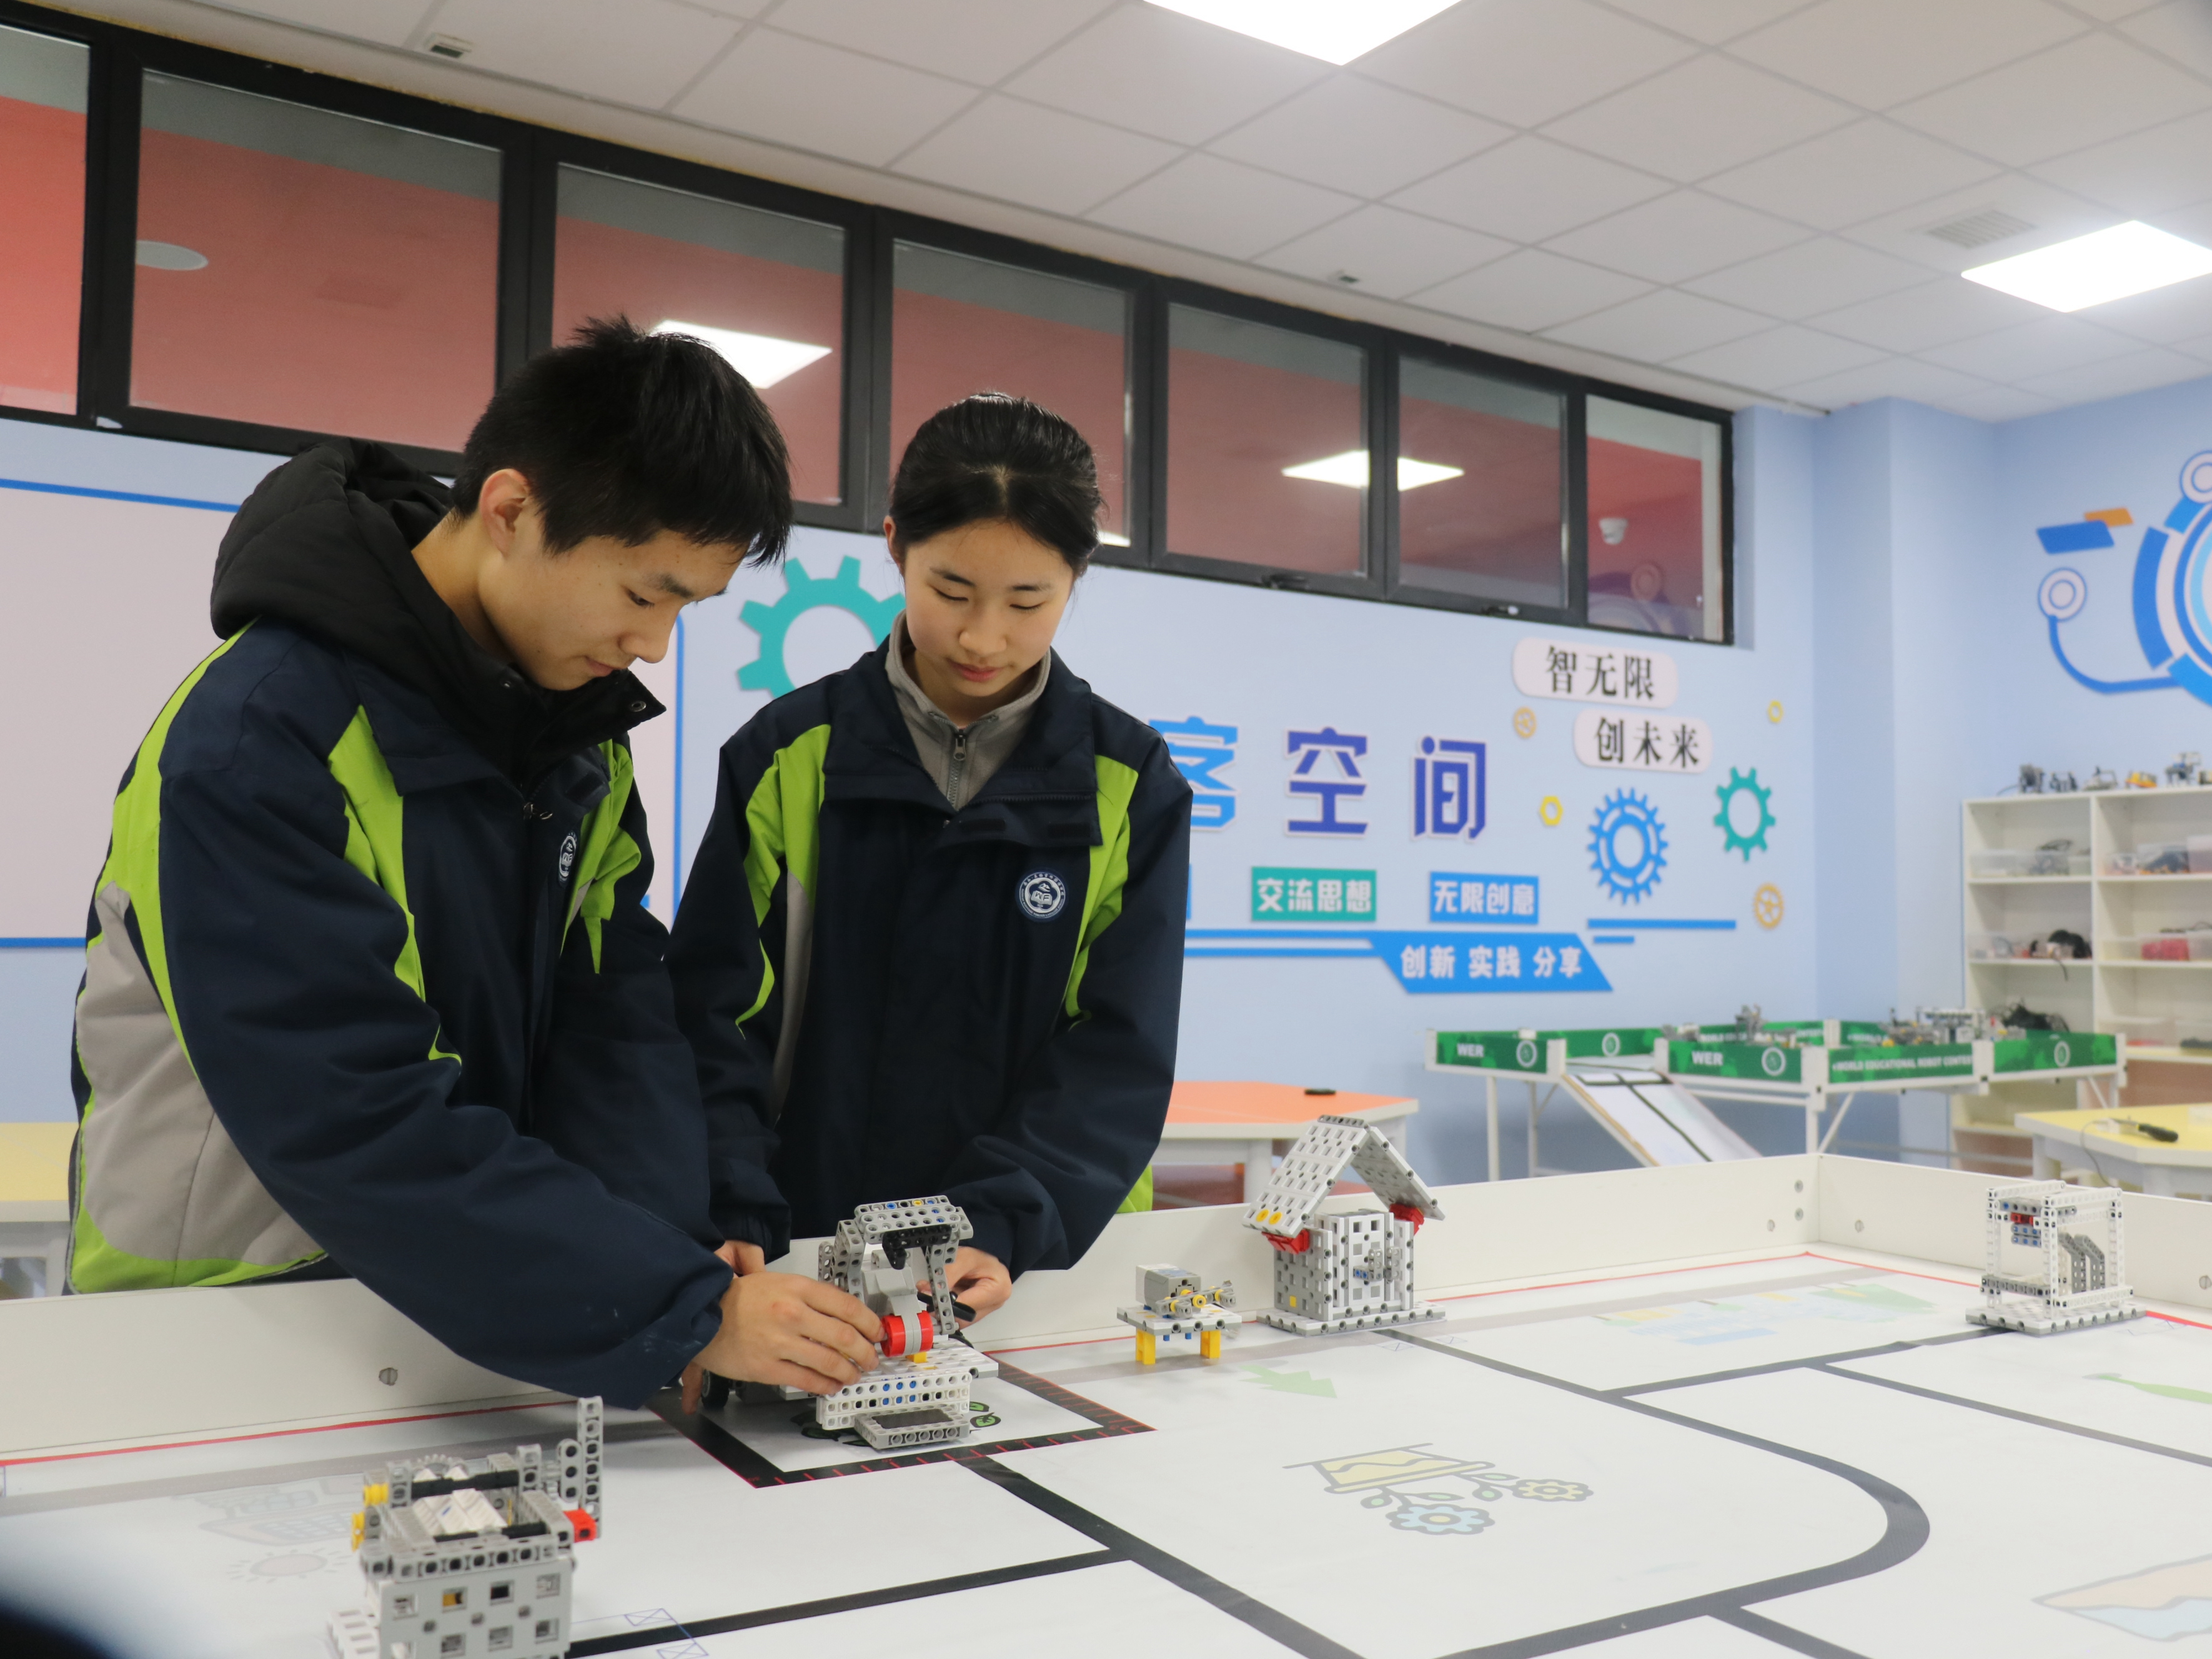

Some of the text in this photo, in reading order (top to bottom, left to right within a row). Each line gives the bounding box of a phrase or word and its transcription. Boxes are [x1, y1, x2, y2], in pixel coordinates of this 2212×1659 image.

[1546, 645, 1654, 700] 智无限
[1594, 716, 1699, 768] 创未来
[1257, 878, 1372, 913] 交流思想
[1434, 880, 1535, 915] 无限创意
[1401, 944, 1582, 979] 创新 实践 分享
[1457, 1042, 1484, 1057] WER
[1692, 1050, 1723, 1066] WER
